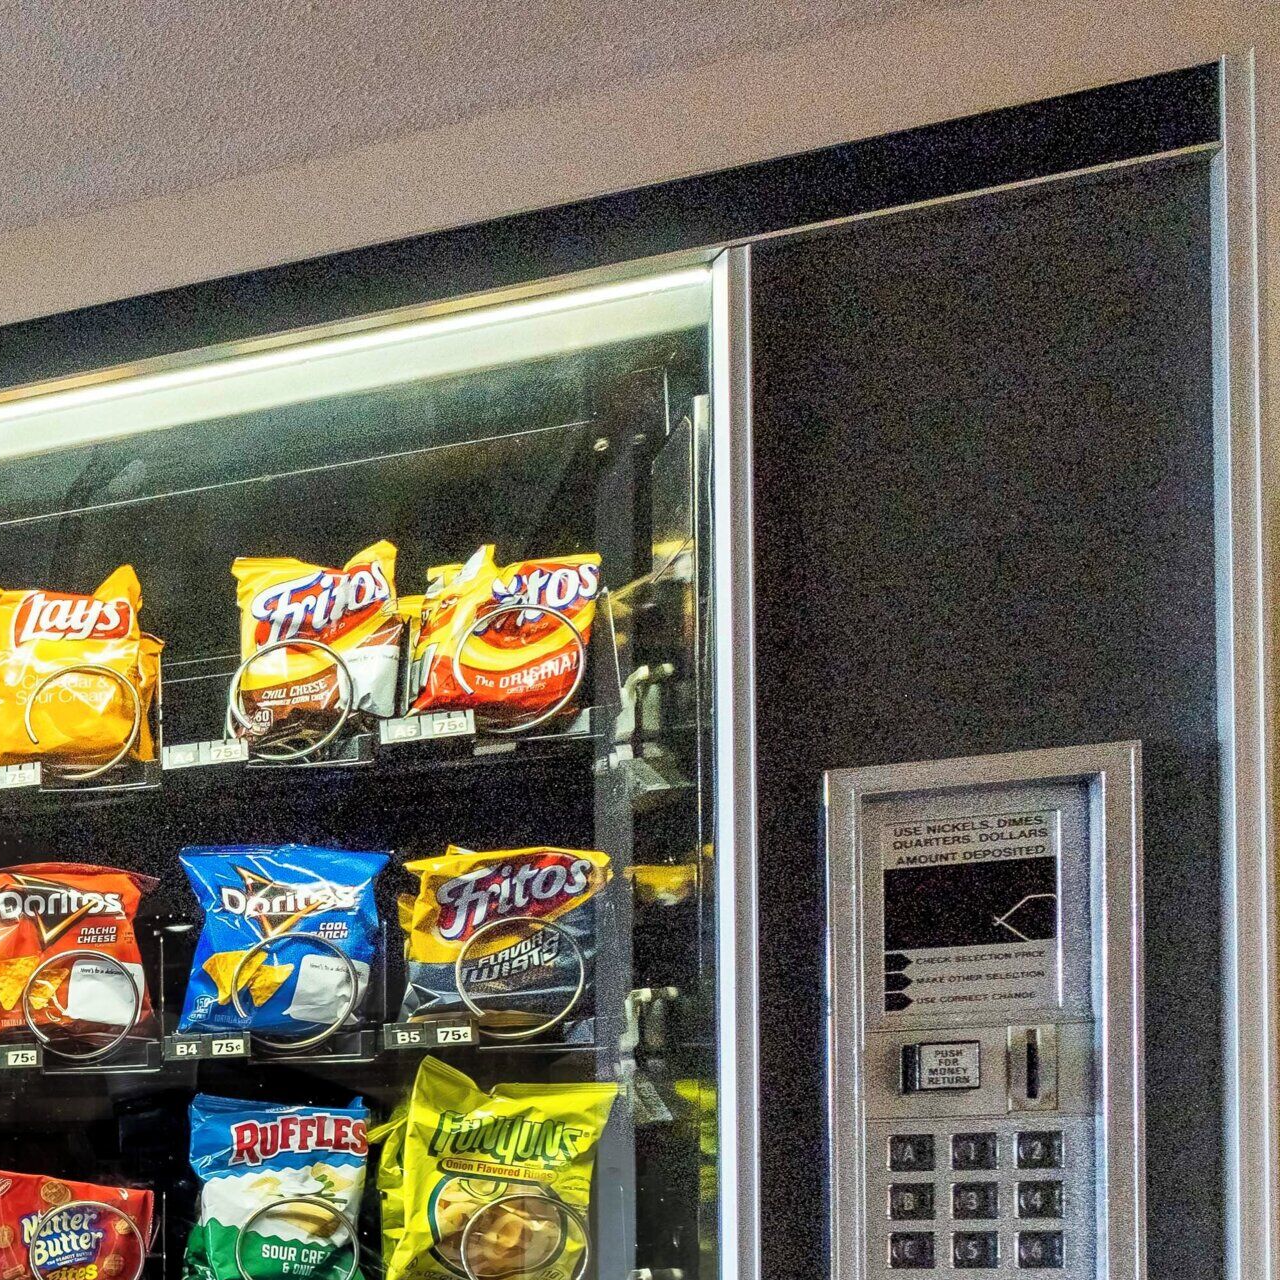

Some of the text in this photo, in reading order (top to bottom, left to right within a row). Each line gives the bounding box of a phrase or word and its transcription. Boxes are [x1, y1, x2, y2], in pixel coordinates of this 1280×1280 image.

[251, 560, 390, 647] Fritos
[475, 675, 494, 688] The
[262, 685, 287, 700] CHILI
[290, 680, 328, 696] CHEESE
[394, 725, 418, 737] A5
[894, 825, 922, 836] USE
[979, 828, 1048, 844] DOLLARS
[897, 845, 1045, 865] AMOUNT DEPOSITED
[221, 886, 358, 916] Doritos
[437, 860, 591, 939] Fritos
[81, 926, 117, 935] NACHO
[319, 922, 348, 931] COOL
[77, 934, 117, 944] CHEESE
[477, 928, 544, 968] FLAVOR
[462, 934, 560, 984] TWISTS
[916, 956, 952, 965] CHECK
[955, 952, 1012, 963] SELECTION
[916, 969, 1046, 985] MAKE OTHER SELECTION
[940, 993, 989, 1003] CORRECT
[992, 990, 1038, 1001] CHANGE
[397, 1032, 420, 1044] B5
[175, 1044, 198, 1055] B4
[934, 1048, 964, 1059] PUSH
[938, 1057, 960, 1067] FOR
[928, 1066, 969, 1077] MONEY
[927, 1075, 971, 1085] RETURN
[229, 1114, 369, 1165] RUFFLES
[446, 1158, 474, 1172] Onion
[476, 1162, 521, 1178] Flavored
[21, 1208, 98, 1244] Nutter
[33, 1231, 104, 1267] Butter
[262, 1244, 296, 1261] SOUR
